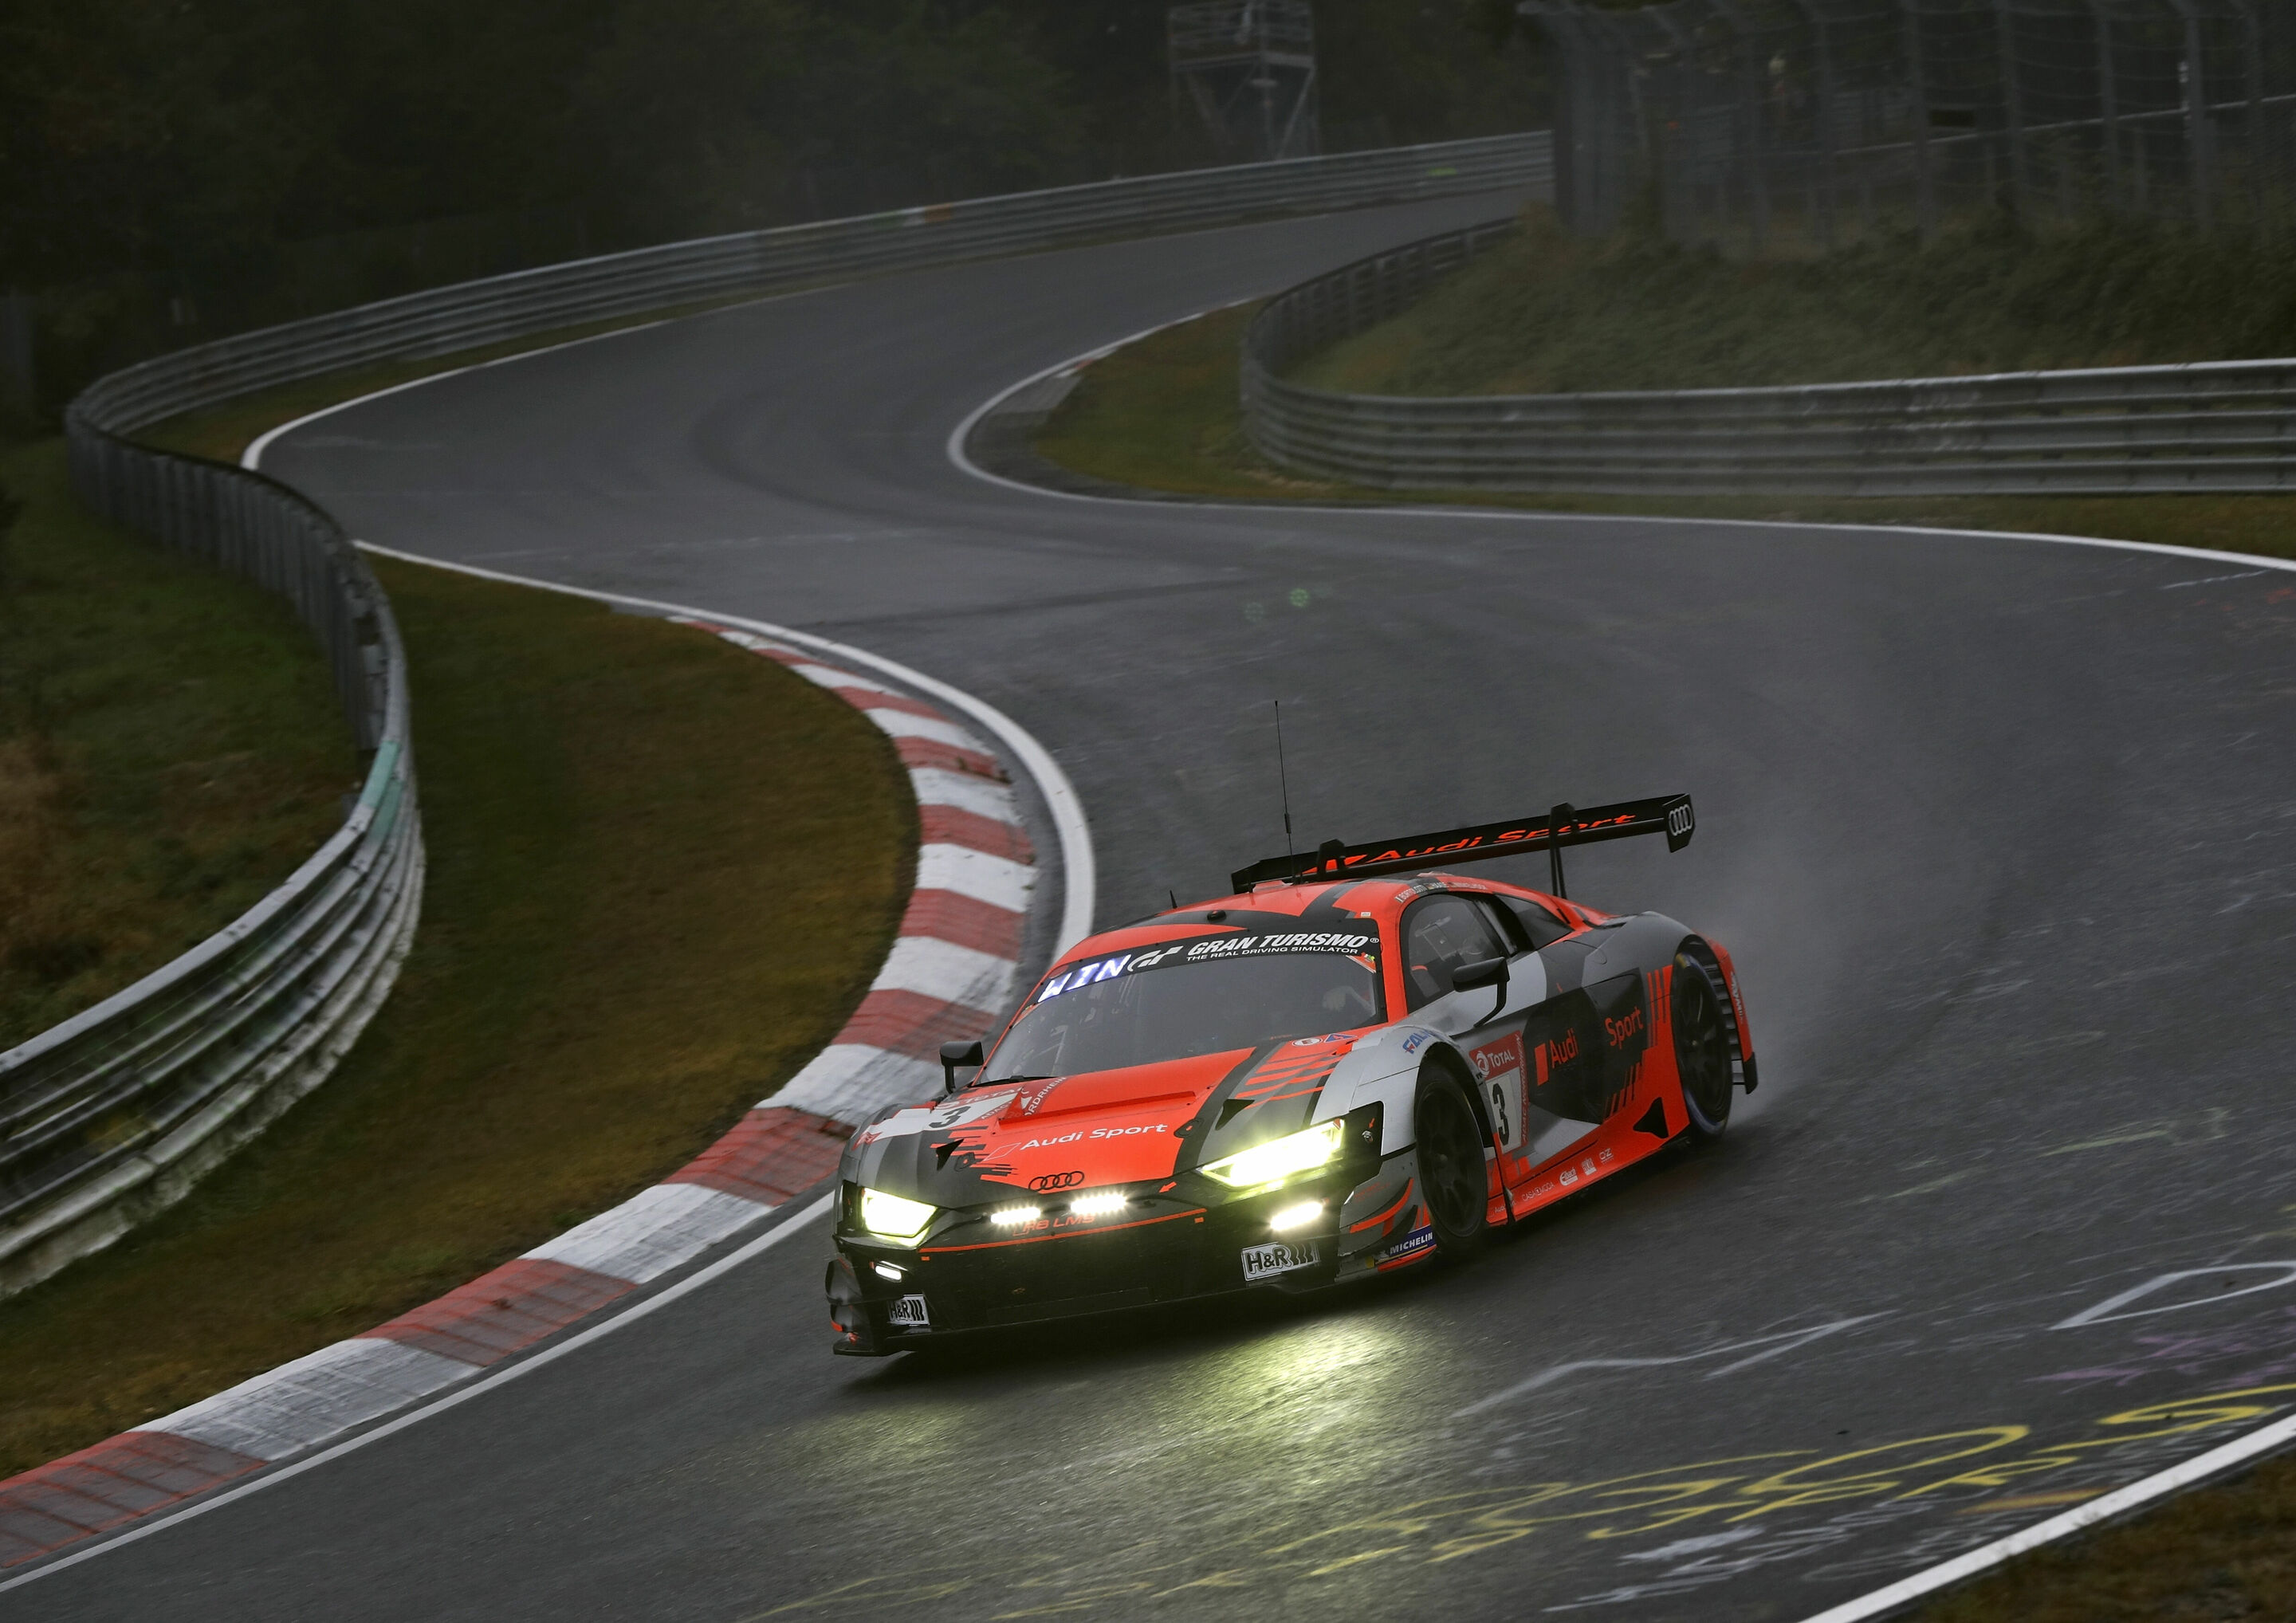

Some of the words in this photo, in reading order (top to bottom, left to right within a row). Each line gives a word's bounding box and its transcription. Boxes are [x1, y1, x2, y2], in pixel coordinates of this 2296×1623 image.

[1366, 836, 1484, 863] Audi
[1187, 937, 1259, 956] GRAN
[1290, 946, 1358, 955] SIMULATOR
[1550, 1028, 1579, 1069] Audi
[1605, 1007, 1644, 1049] Sport
[1489, 1049, 1516, 1069] TOTAL
[929, 1106, 971, 1129] 3
[1492, 1083, 1510, 1146] 3
[1020, 1130, 1083, 1151] Audi
[1087, 1122, 1168, 1142] Sport
[1390, 1232, 1433, 1256] MICHELIN
[1245, 1248, 1290, 1272] H&R
